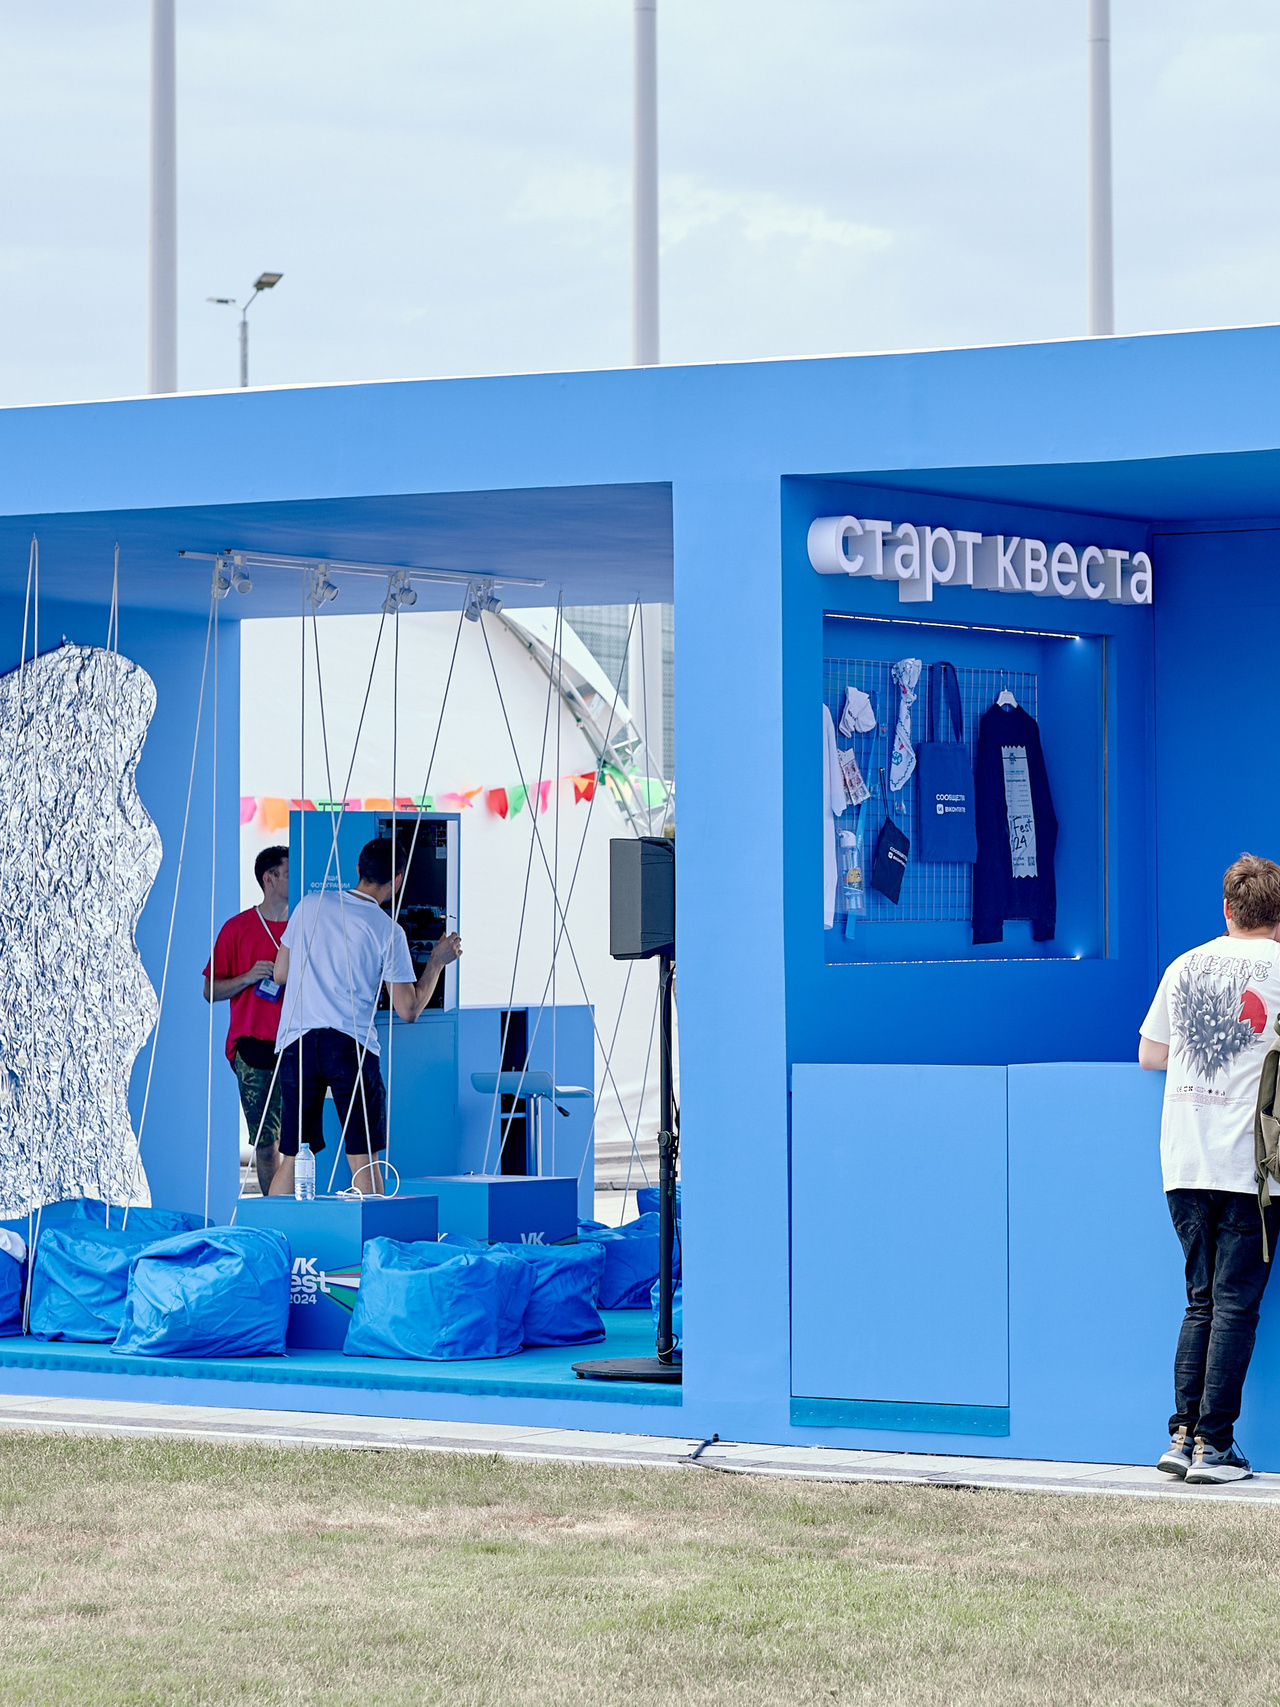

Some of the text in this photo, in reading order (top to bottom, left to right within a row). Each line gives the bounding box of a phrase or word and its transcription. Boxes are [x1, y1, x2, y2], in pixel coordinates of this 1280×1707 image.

[814, 514, 1153, 604] старт квеста
[1183, 953, 1273, 982] HEART
[290, 1271, 331, 1293] est
